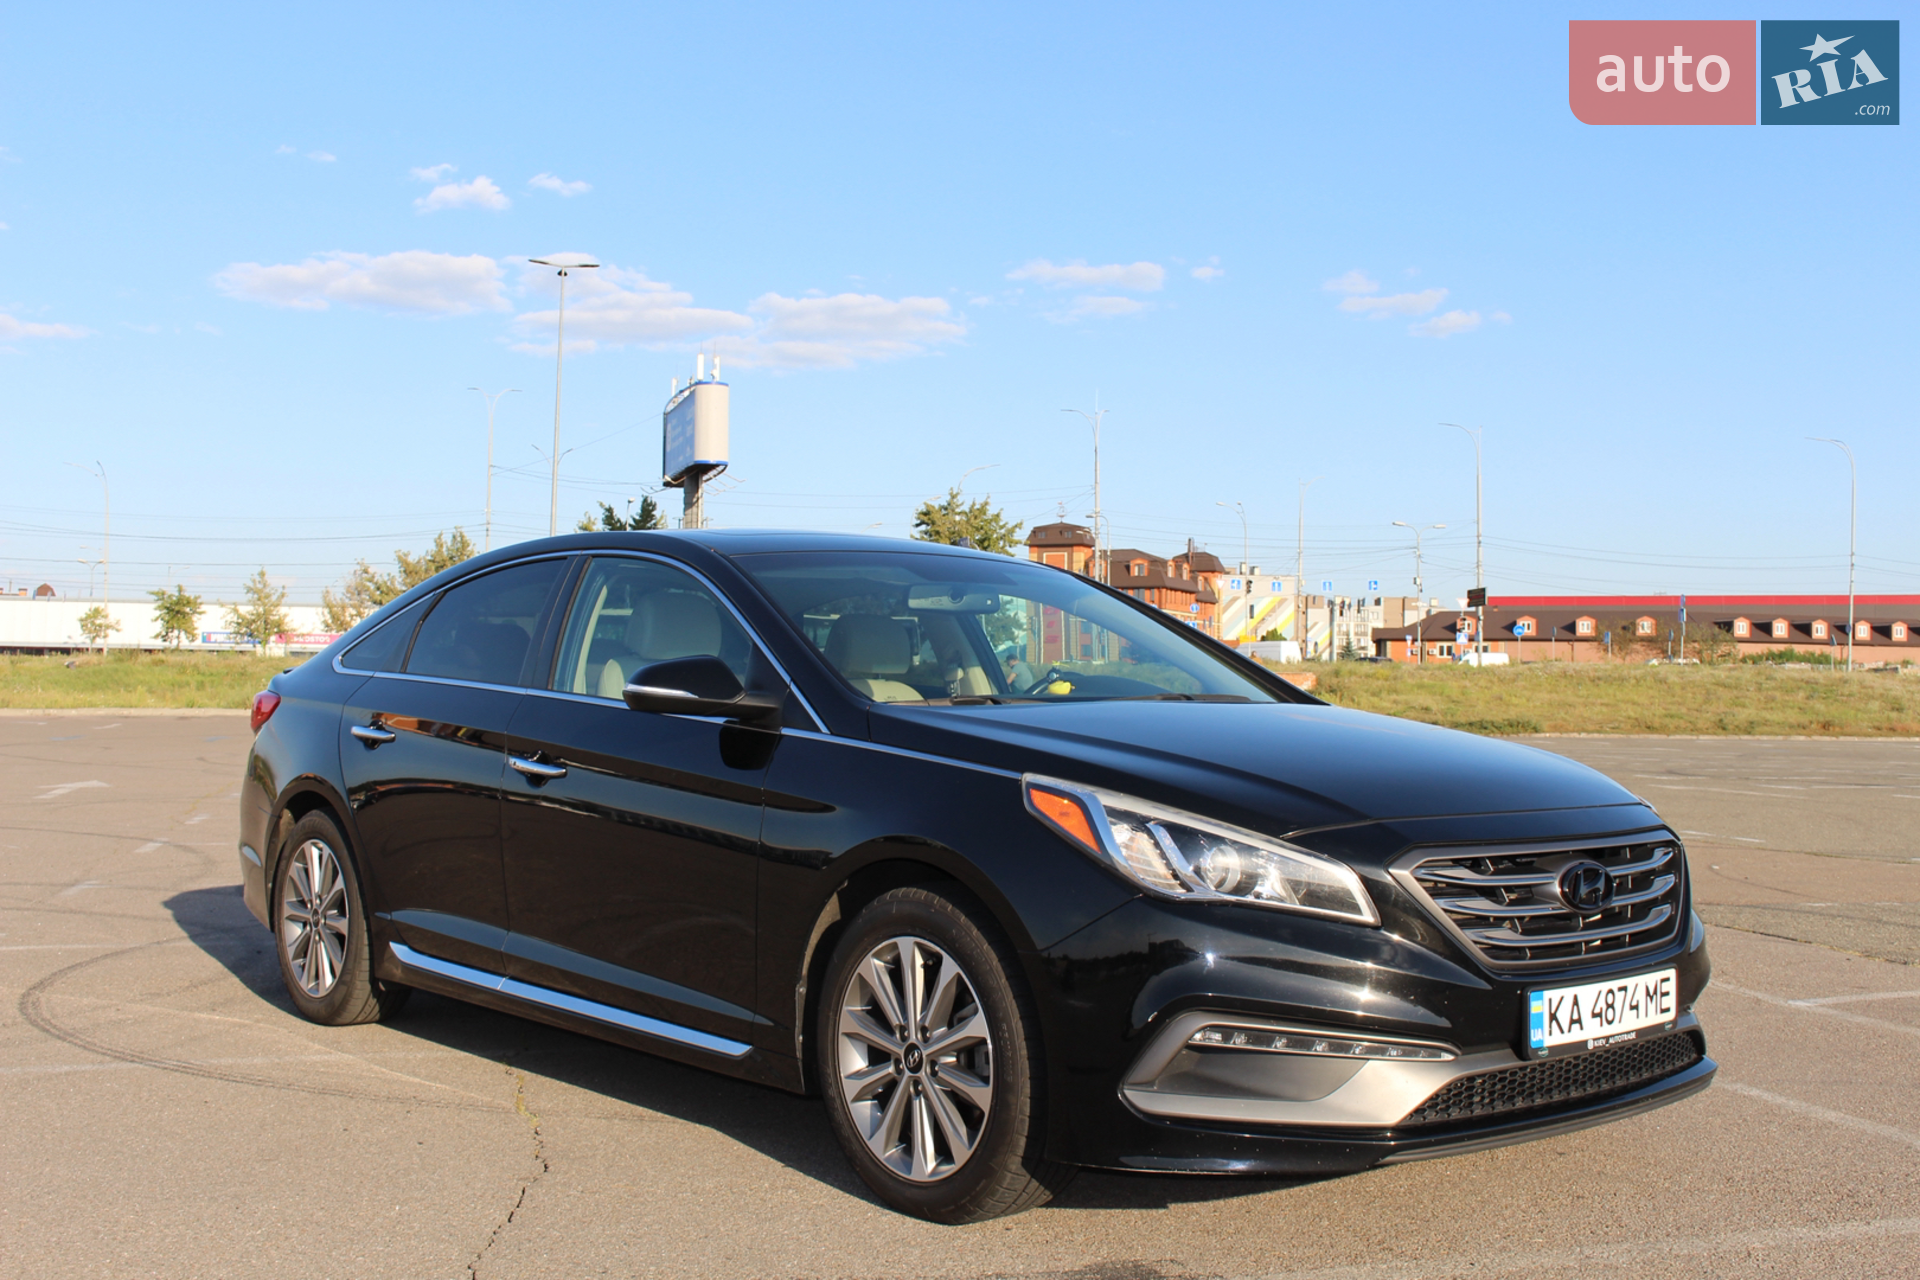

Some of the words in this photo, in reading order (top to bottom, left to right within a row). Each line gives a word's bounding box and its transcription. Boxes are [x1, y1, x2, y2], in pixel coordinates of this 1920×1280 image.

[1548, 993, 1584, 1037] KA
[1591, 983, 1639, 1027] 4874
[1645, 976, 1671, 1018] ME
[1531, 1028, 1543, 1041] UA
